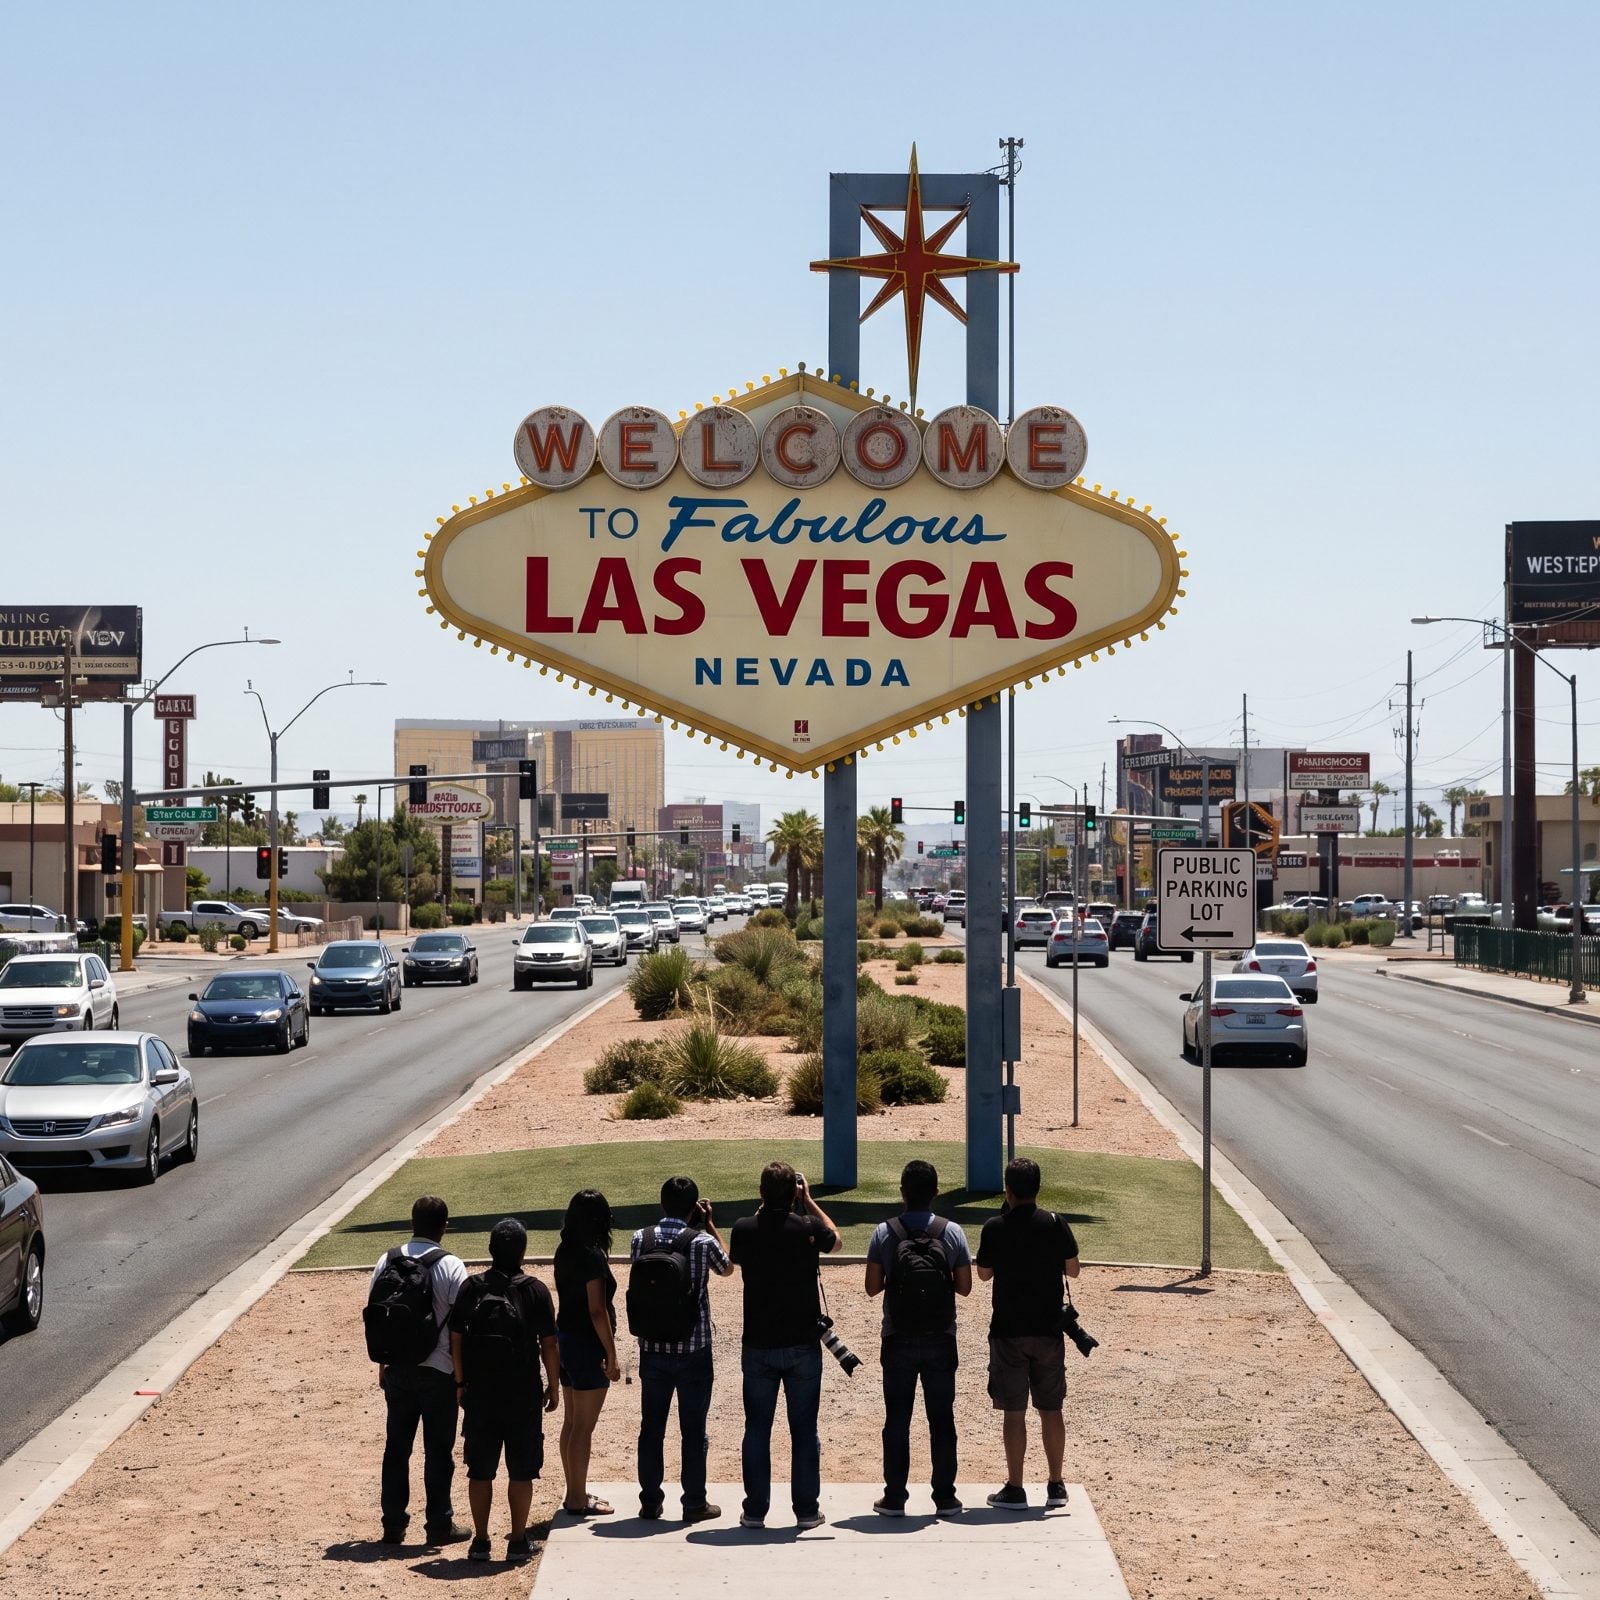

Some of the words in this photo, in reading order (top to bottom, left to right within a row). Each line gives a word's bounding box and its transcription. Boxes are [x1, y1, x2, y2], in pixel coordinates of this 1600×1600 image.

[524, 422, 1067, 474] WELCOME
[579, 508, 638, 539] TO
[661, 496, 1007, 552] Fabulous
[526, 556, 705, 635] LAS
[742, 559, 1077, 640] VEGAS
[695, 657, 909, 687] NEVADA
[1173, 857, 1241, 875] PUBLIC
[1166, 881, 1248, 898] PARKING
[1190, 904, 1224, 920] LOT
